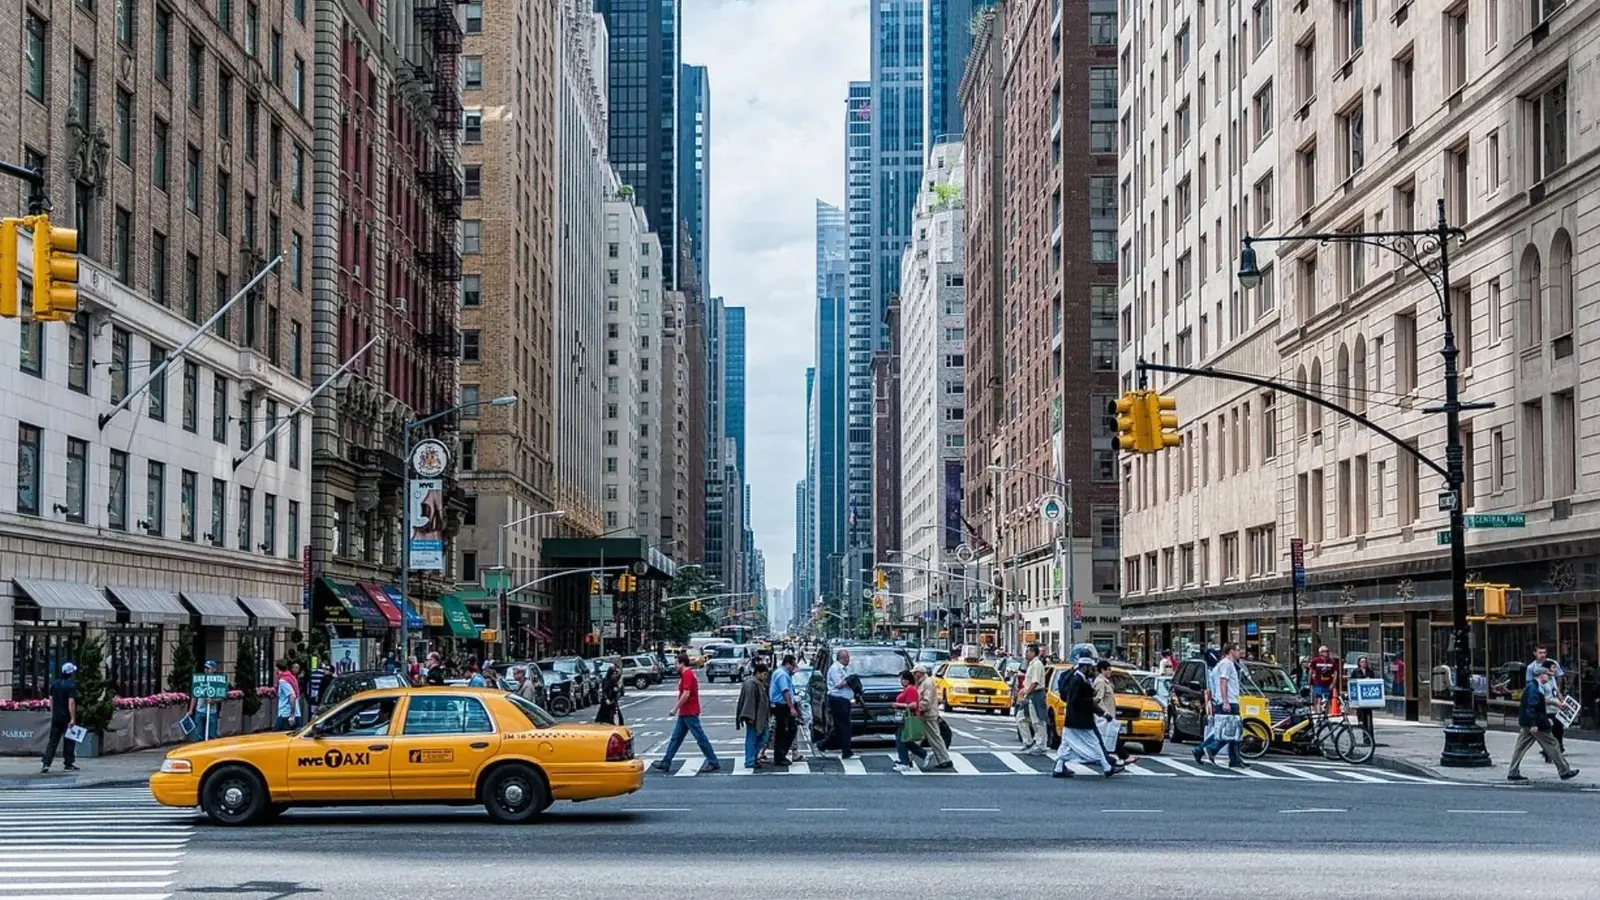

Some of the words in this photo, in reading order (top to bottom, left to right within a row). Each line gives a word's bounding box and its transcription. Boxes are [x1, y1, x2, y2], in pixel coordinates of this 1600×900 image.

[1475, 516, 1504, 524] CENTRAL
[1507, 515, 1523, 523] PARK
[298, 757, 323, 767] NYC
[324, 749, 370, 768] TAXI
